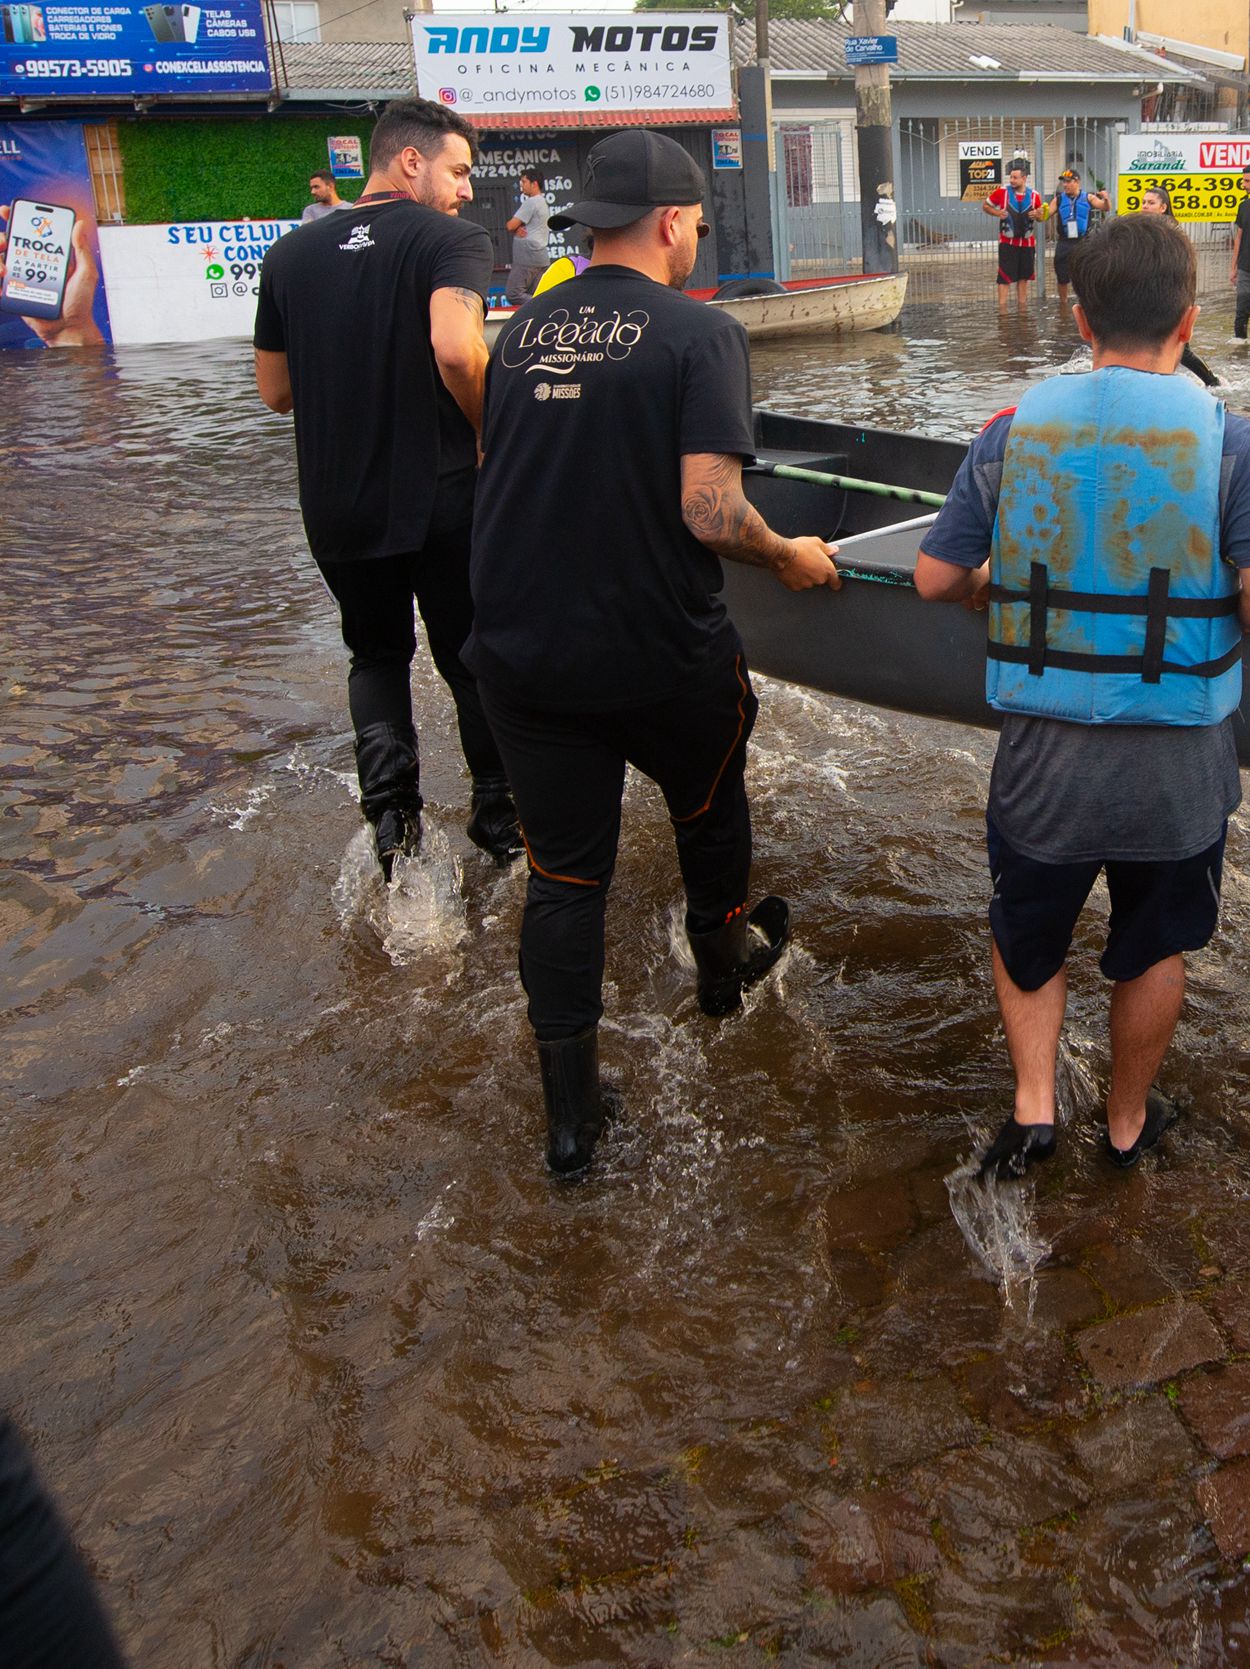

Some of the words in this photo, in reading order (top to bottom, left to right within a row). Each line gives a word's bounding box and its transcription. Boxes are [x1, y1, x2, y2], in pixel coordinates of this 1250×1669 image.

[46, 7, 89, 15] CONECTOR
[91, 7, 102, 15] DE
[103, 7, 131, 15] CARGA
[205, 10, 231, 18] TELAS
[48, 24, 87, 32] BATERIAS
[89, 24, 95, 32] E
[96, 24, 123, 32] FONES
[207, 29, 237, 37] CABOS
[238, 29, 256, 37] USB
[423, 26, 551, 54] ANDY
[568, 25, 718, 52] MOTOS
[855, 44, 883, 52] Carvalho
[26, 59, 132, 77] 99573-5905
[156, 60, 265, 73] CONEXCELLASSISTENCIA
[457, 63, 555, 75] OFICINA
[575, 60, 690, 73] MECÂNICA
[604, 83, 715, 103] (51)984724680
[478, 147, 561, 165] MECÂNICA
[962, 146, 999, 156] VENDE
[1129, 159, 1186, 171] Sarandi
[168, 226, 213, 244] SEU
[12, 236, 64, 256] TROCA
[15, 249, 28, 257] DE
[34, 251, 60, 263] TELA
[25, 261, 58, 271] PARTIR
[25, 268, 47, 283] 99
[579, 305, 596, 315] UM
[503, 308, 649, 361] Legado
[539, 350, 604, 364] MISSIONÁRIO
[552, 387, 581, 399] MISSÕES
